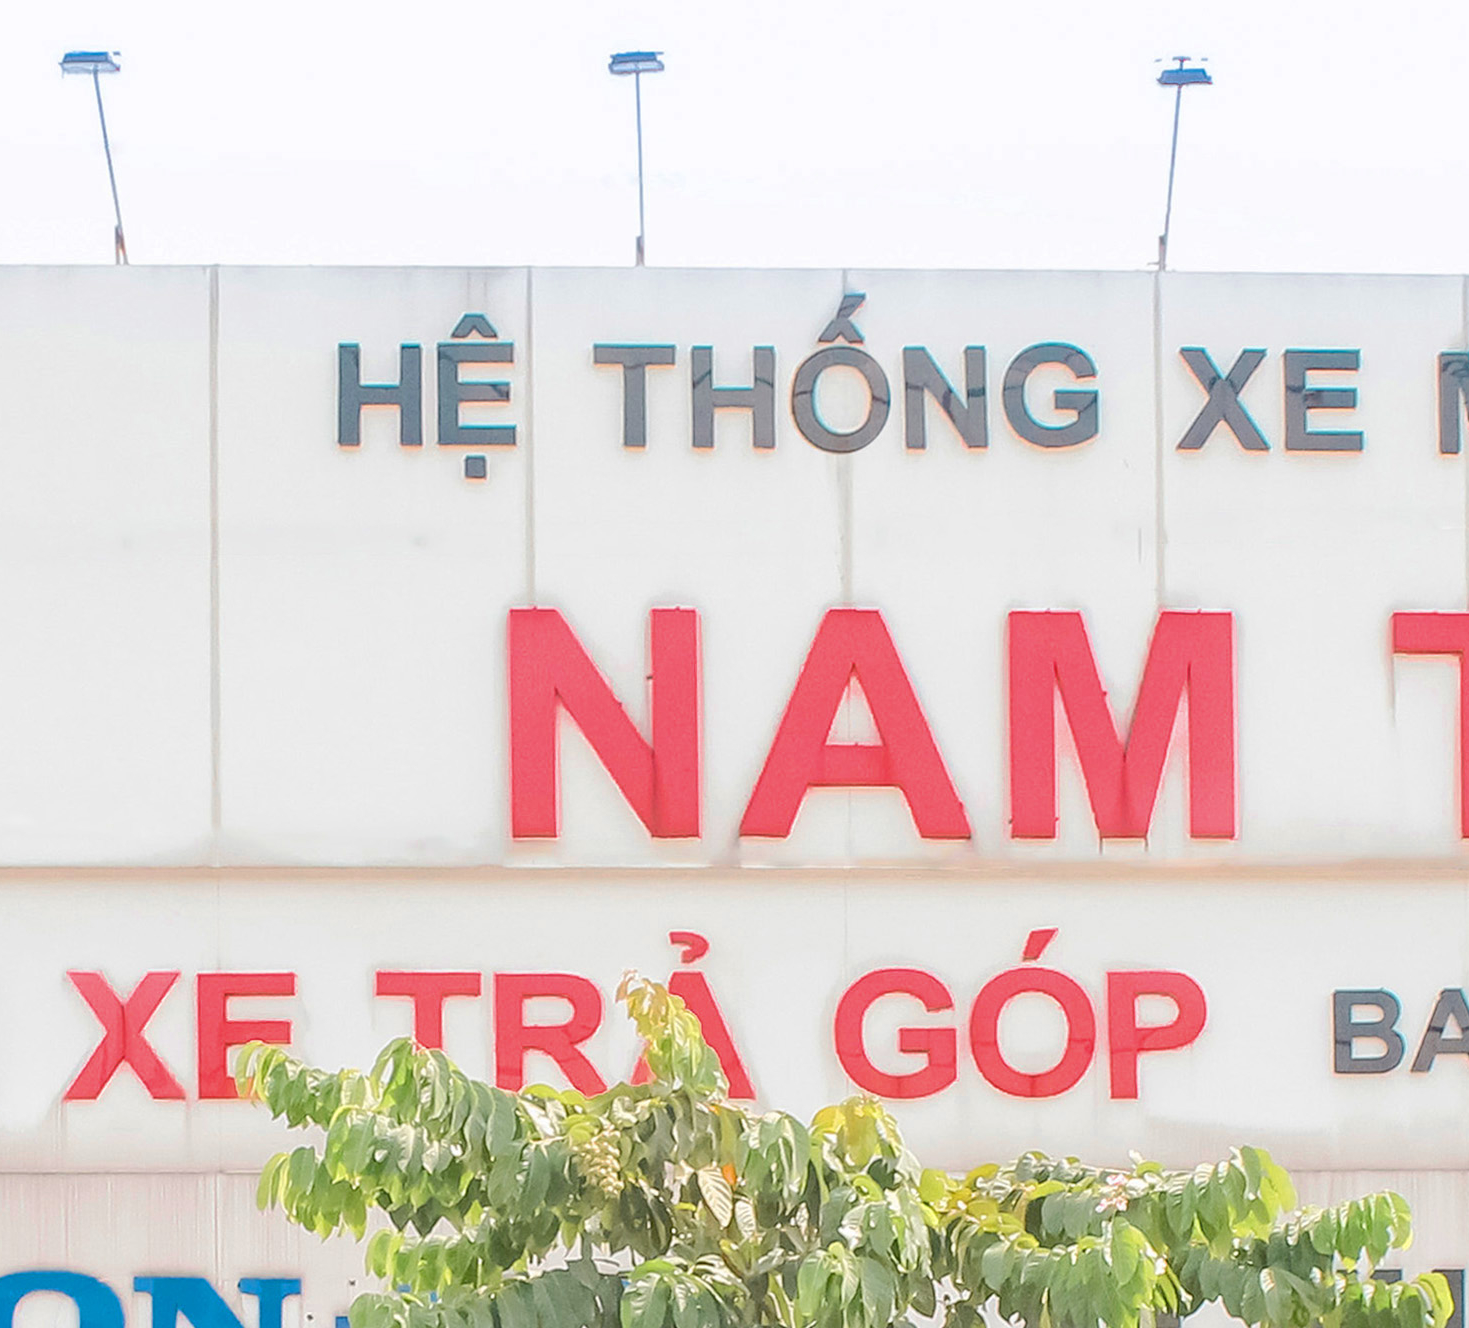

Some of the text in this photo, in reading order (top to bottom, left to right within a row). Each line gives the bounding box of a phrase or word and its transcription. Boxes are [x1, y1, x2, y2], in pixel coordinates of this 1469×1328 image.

[337, 313, 517, 479] HỆ
[594, 292, 1101, 453] THỐNG
[1177, 346, 1365, 451] XE
[508, 606, 1238, 840] NAM
[62, 970, 296, 1101] XE
[834, 928, 1207, 1101] GÓP
